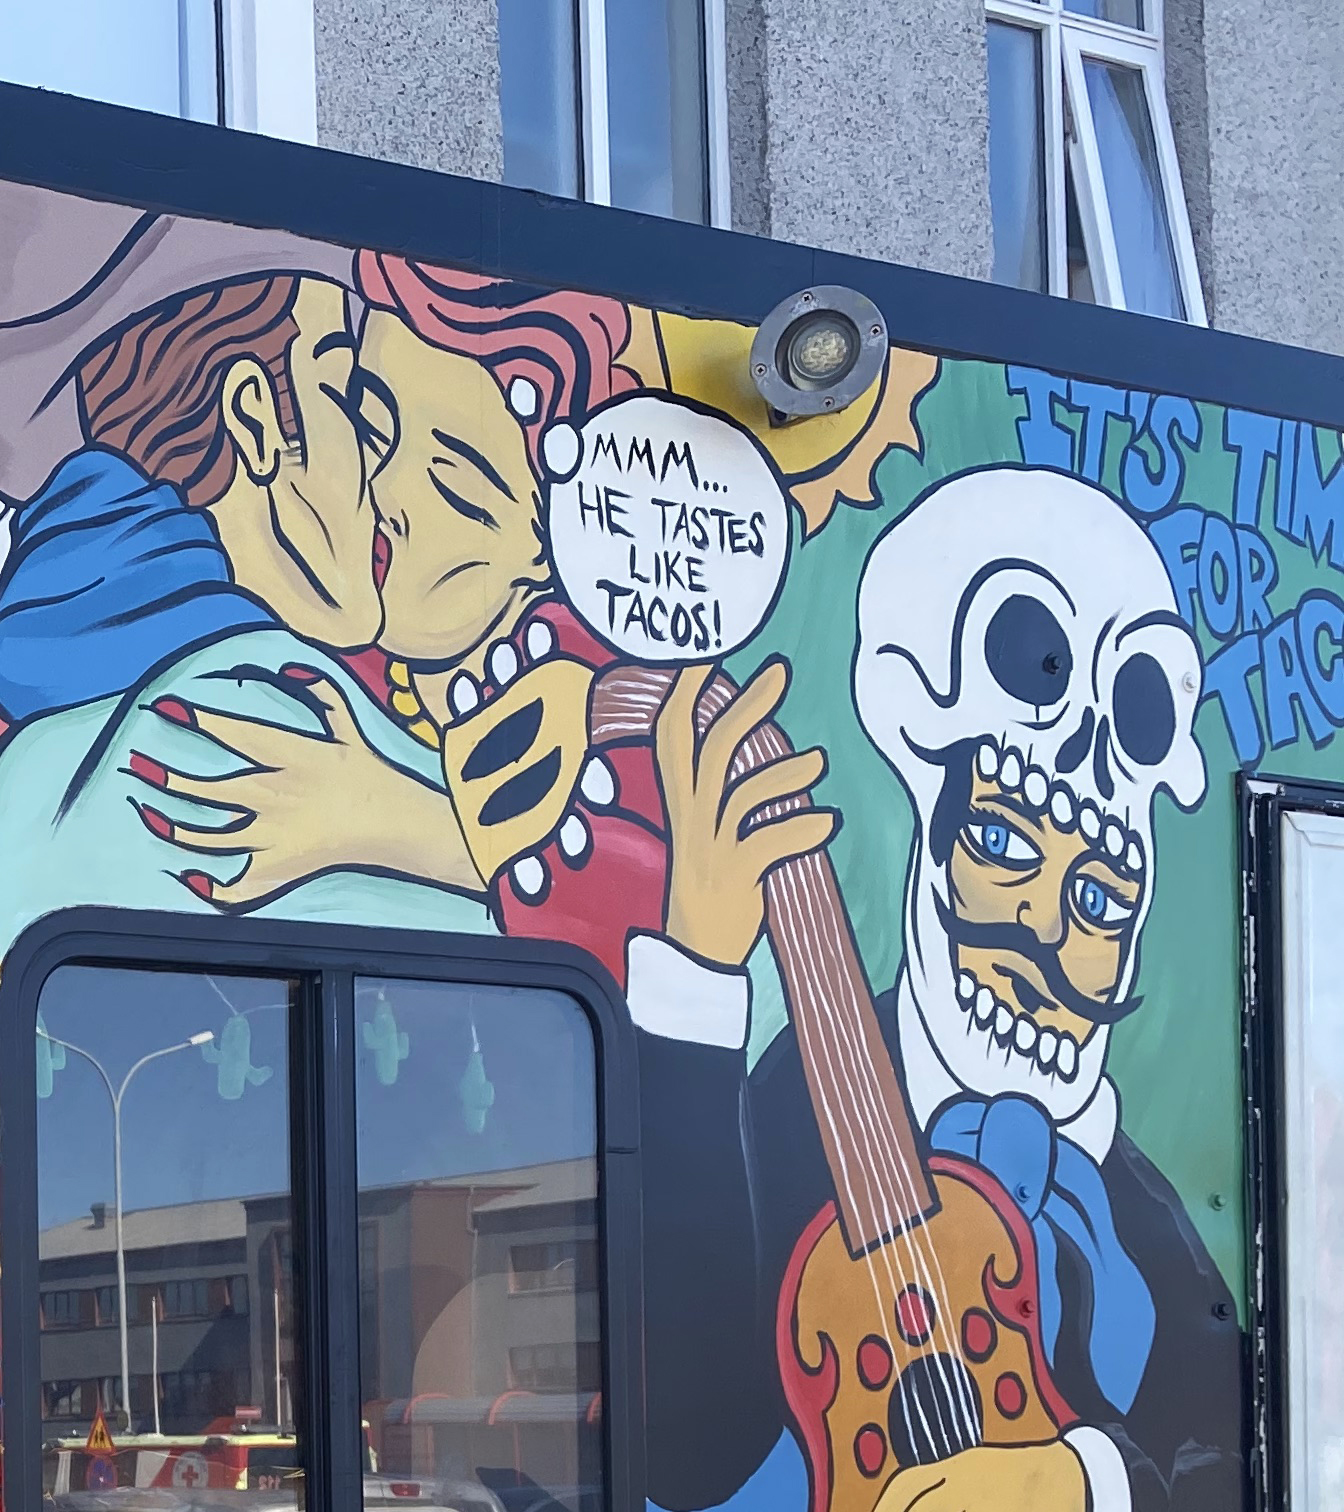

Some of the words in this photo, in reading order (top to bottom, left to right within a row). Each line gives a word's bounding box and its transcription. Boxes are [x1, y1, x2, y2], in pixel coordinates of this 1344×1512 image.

[589, 432, 729, 493] MMM...
[1004, 362, 1202, 514] IT'S
[576, 480, 636, 539] HE
[650, 497, 767, 559] TASTES
[628, 543, 710, 593] LIKE
[1148, 504, 1282, 640] FOR
[595, 578, 723, 652] TACOS!
